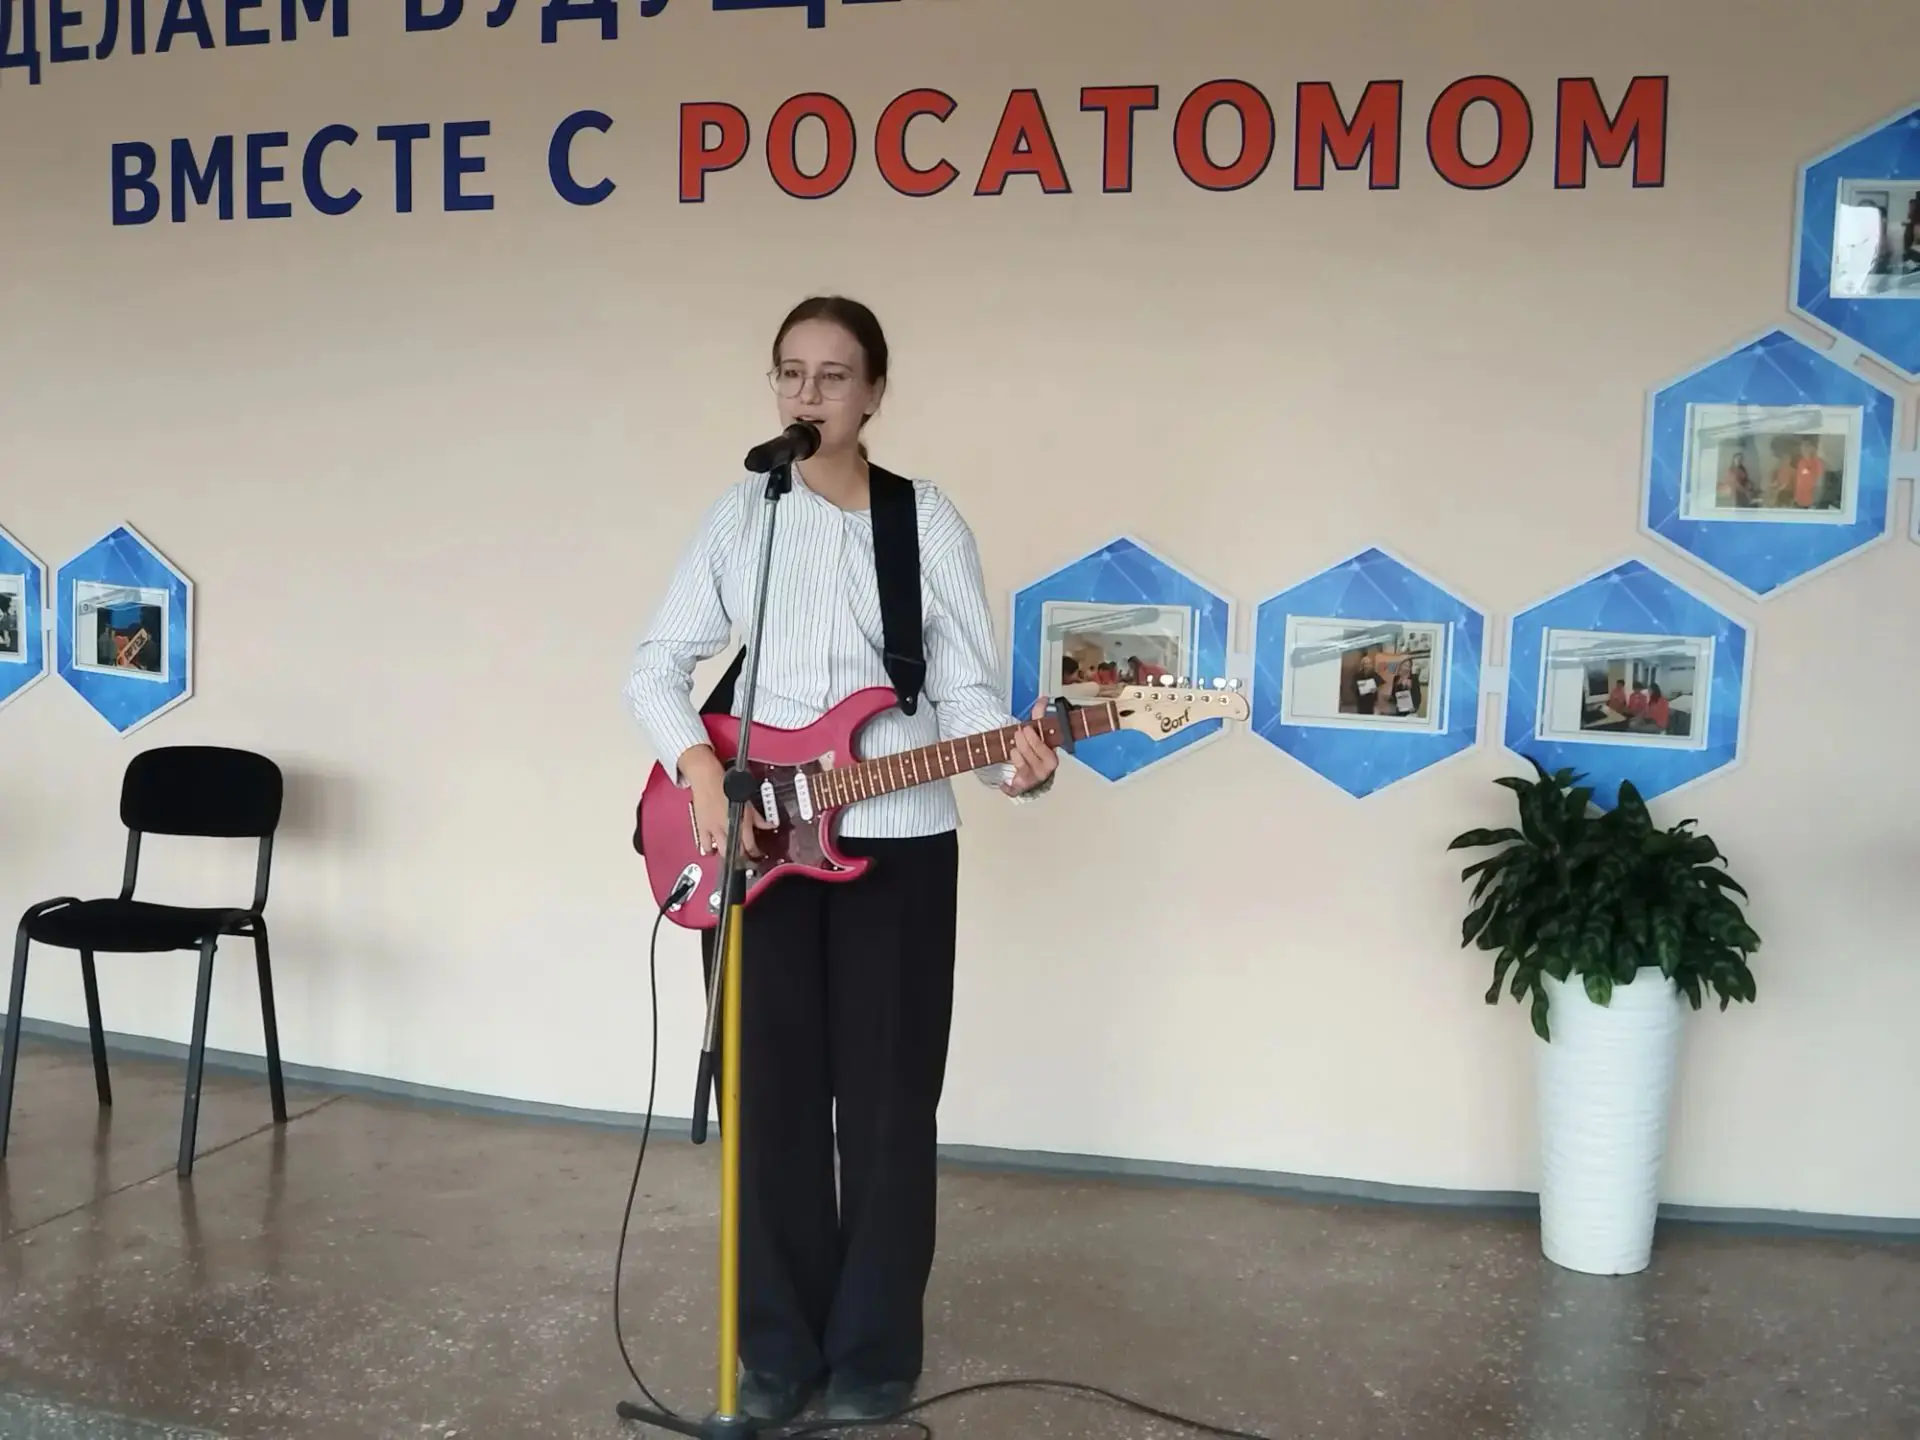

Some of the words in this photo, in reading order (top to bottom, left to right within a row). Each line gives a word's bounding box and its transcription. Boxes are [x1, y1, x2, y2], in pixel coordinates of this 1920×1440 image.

[112, 120, 494, 226] ВМЕСТЕ
[548, 109, 616, 206] С
[679, 75, 1669, 202] РОСАТОМОМ
[1160, 708, 1190, 733] Cort
